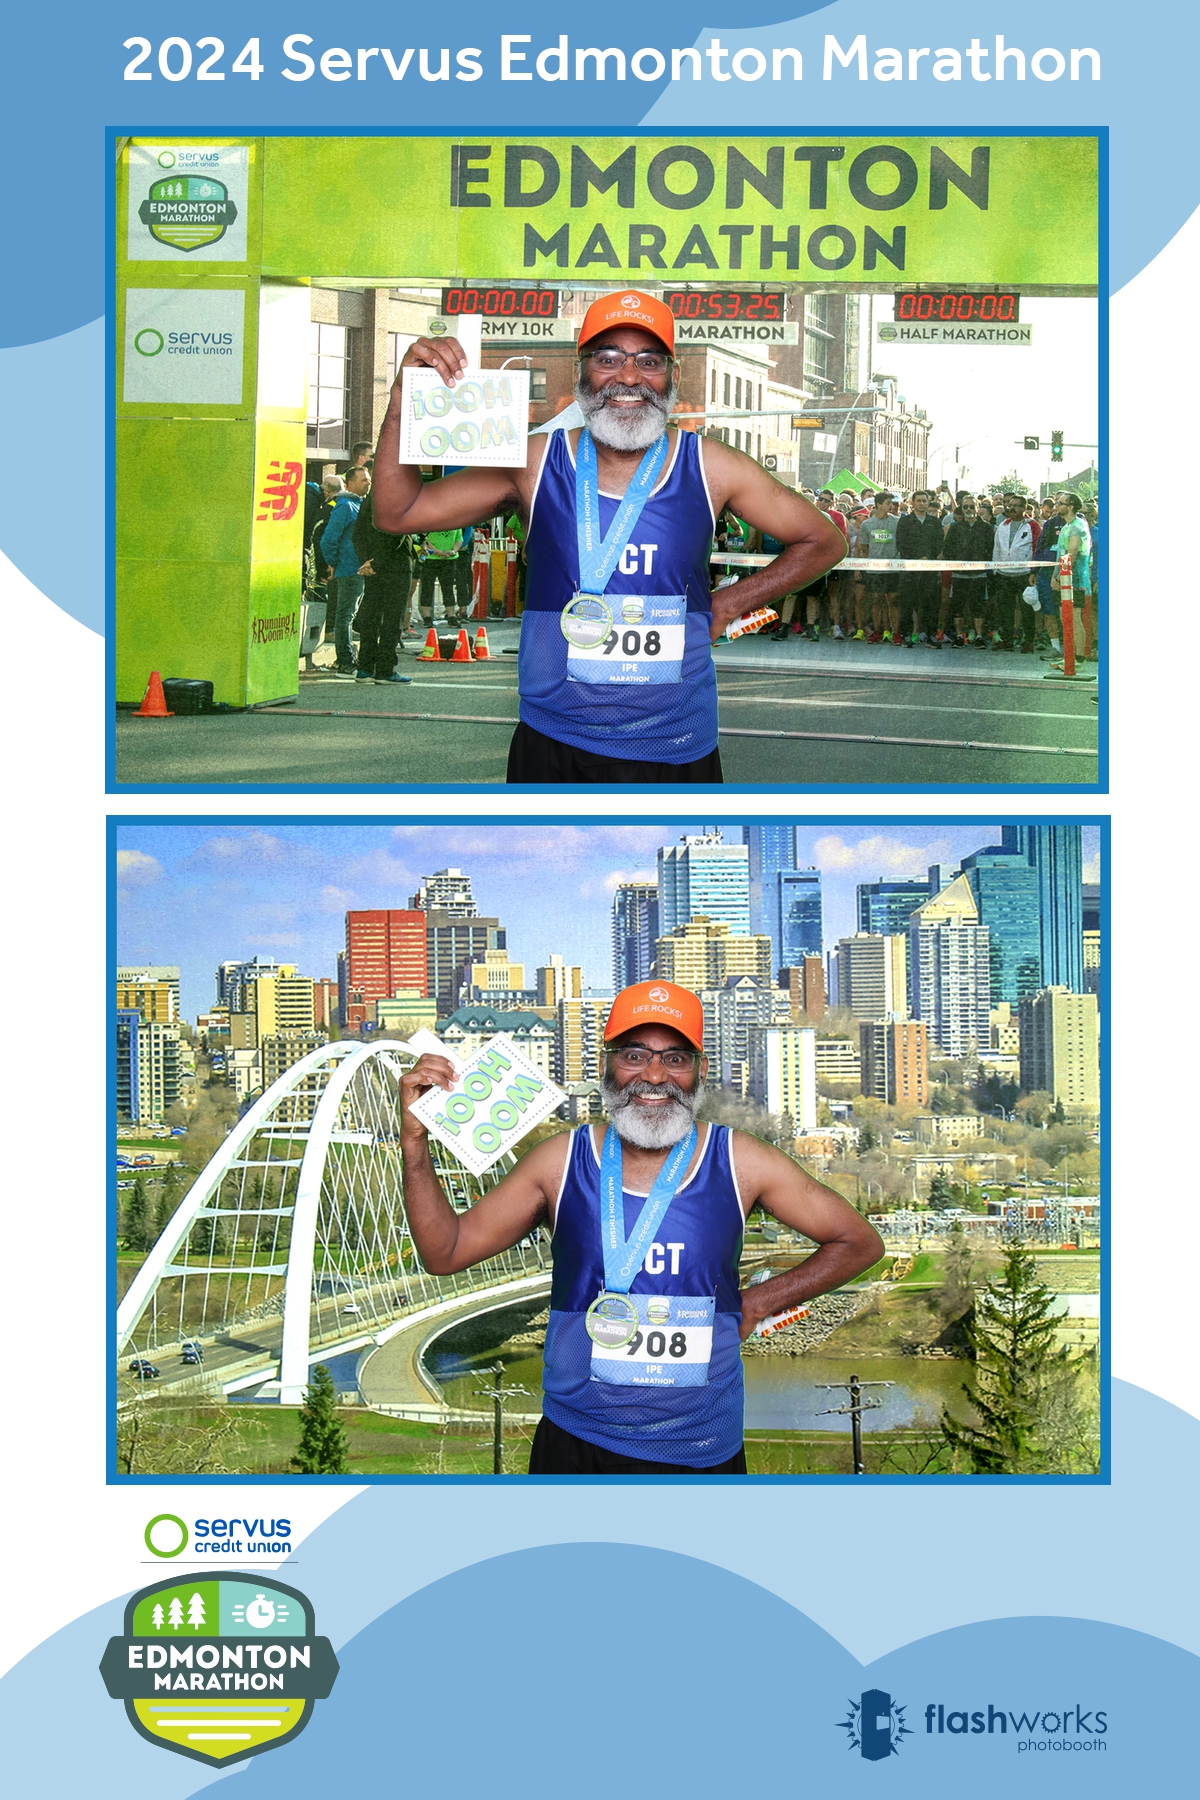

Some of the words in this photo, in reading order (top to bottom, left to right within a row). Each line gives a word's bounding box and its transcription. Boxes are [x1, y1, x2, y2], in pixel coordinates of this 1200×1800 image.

[178, 152, 220, 162] servus
[450, 144, 990, 211] EDMONTON
[149, 201, 227, 214] EDMONTON
[160, 214, 216, 222] MARATHON
[523, 222, 906, 271] MARATHON
[605, 311, 622, 320] LIFE
[623, 310, 655, 325] ROCKS!
[481, 321, 517, 335] RMY
[522, 322, 554, 336] 10K
[678, 325, 785, 340] MARATHON
[900, 328, 938, 340] HALF
[943, 328, 1031, 341] MARATHON
[168, 331, 233, 345] servus
[167, 345, 200, 355] credit
[202, 346, 233, 355] union
[640, 454, 658, 486] MARATHON
[583, 480, 591, 517] MARATHON
[601, 544, 616, 569] servus
[612, 523, 626, 544] credit
[622, 503, 635, 523] union
[602, 630, 661, 656] 908
[622, 663, 638, 672] IPE
[609, 675, 650, 683] MARATHON
[632, 1004, 650, 1014] LIFE
[651, 1004, 683, 1020] ROCKS!
[666, 1149, 685, 1183] MARATHON
[608, 1176, 616, 1214] MARATHON
[609, 1214, 617, 1250] FINISHER
[626, 1241, 641, 1267] servus
[638, 1220, 652, 1242] credit
[648, 1200, 661, 1220] union
[626, 1331, 687, 1358] 908
[646, 1364, 663, 1374] IPE
[632, 1376, 675, 1385] MARATHON
